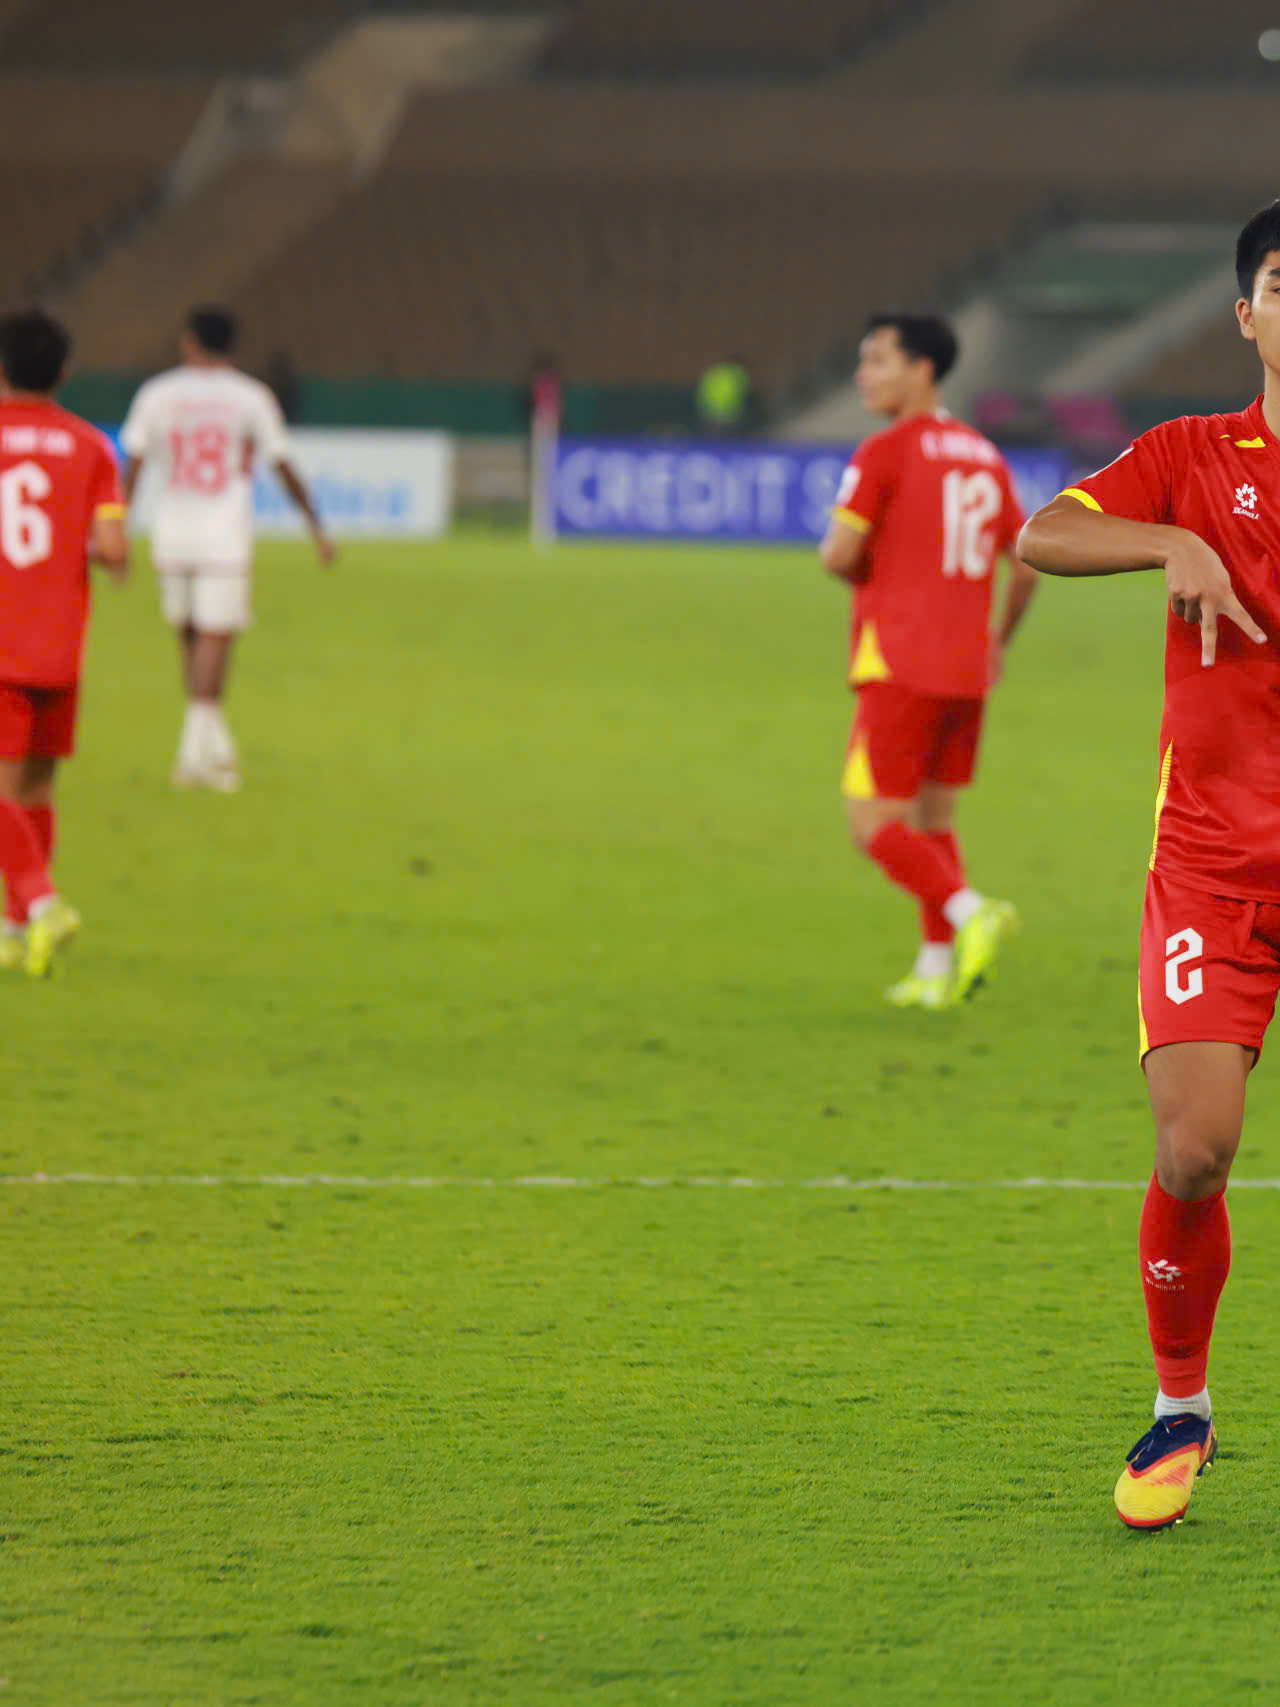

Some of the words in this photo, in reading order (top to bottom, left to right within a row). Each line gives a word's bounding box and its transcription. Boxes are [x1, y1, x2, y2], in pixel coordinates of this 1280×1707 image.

[168, 425, 229, 496] 18
[560, 449, 795, 532] CREDIT
[1, 461, 51, 569] 6
[942, 471, 1002, 580] 12
[1165, 928, 1203, 1005] 2
